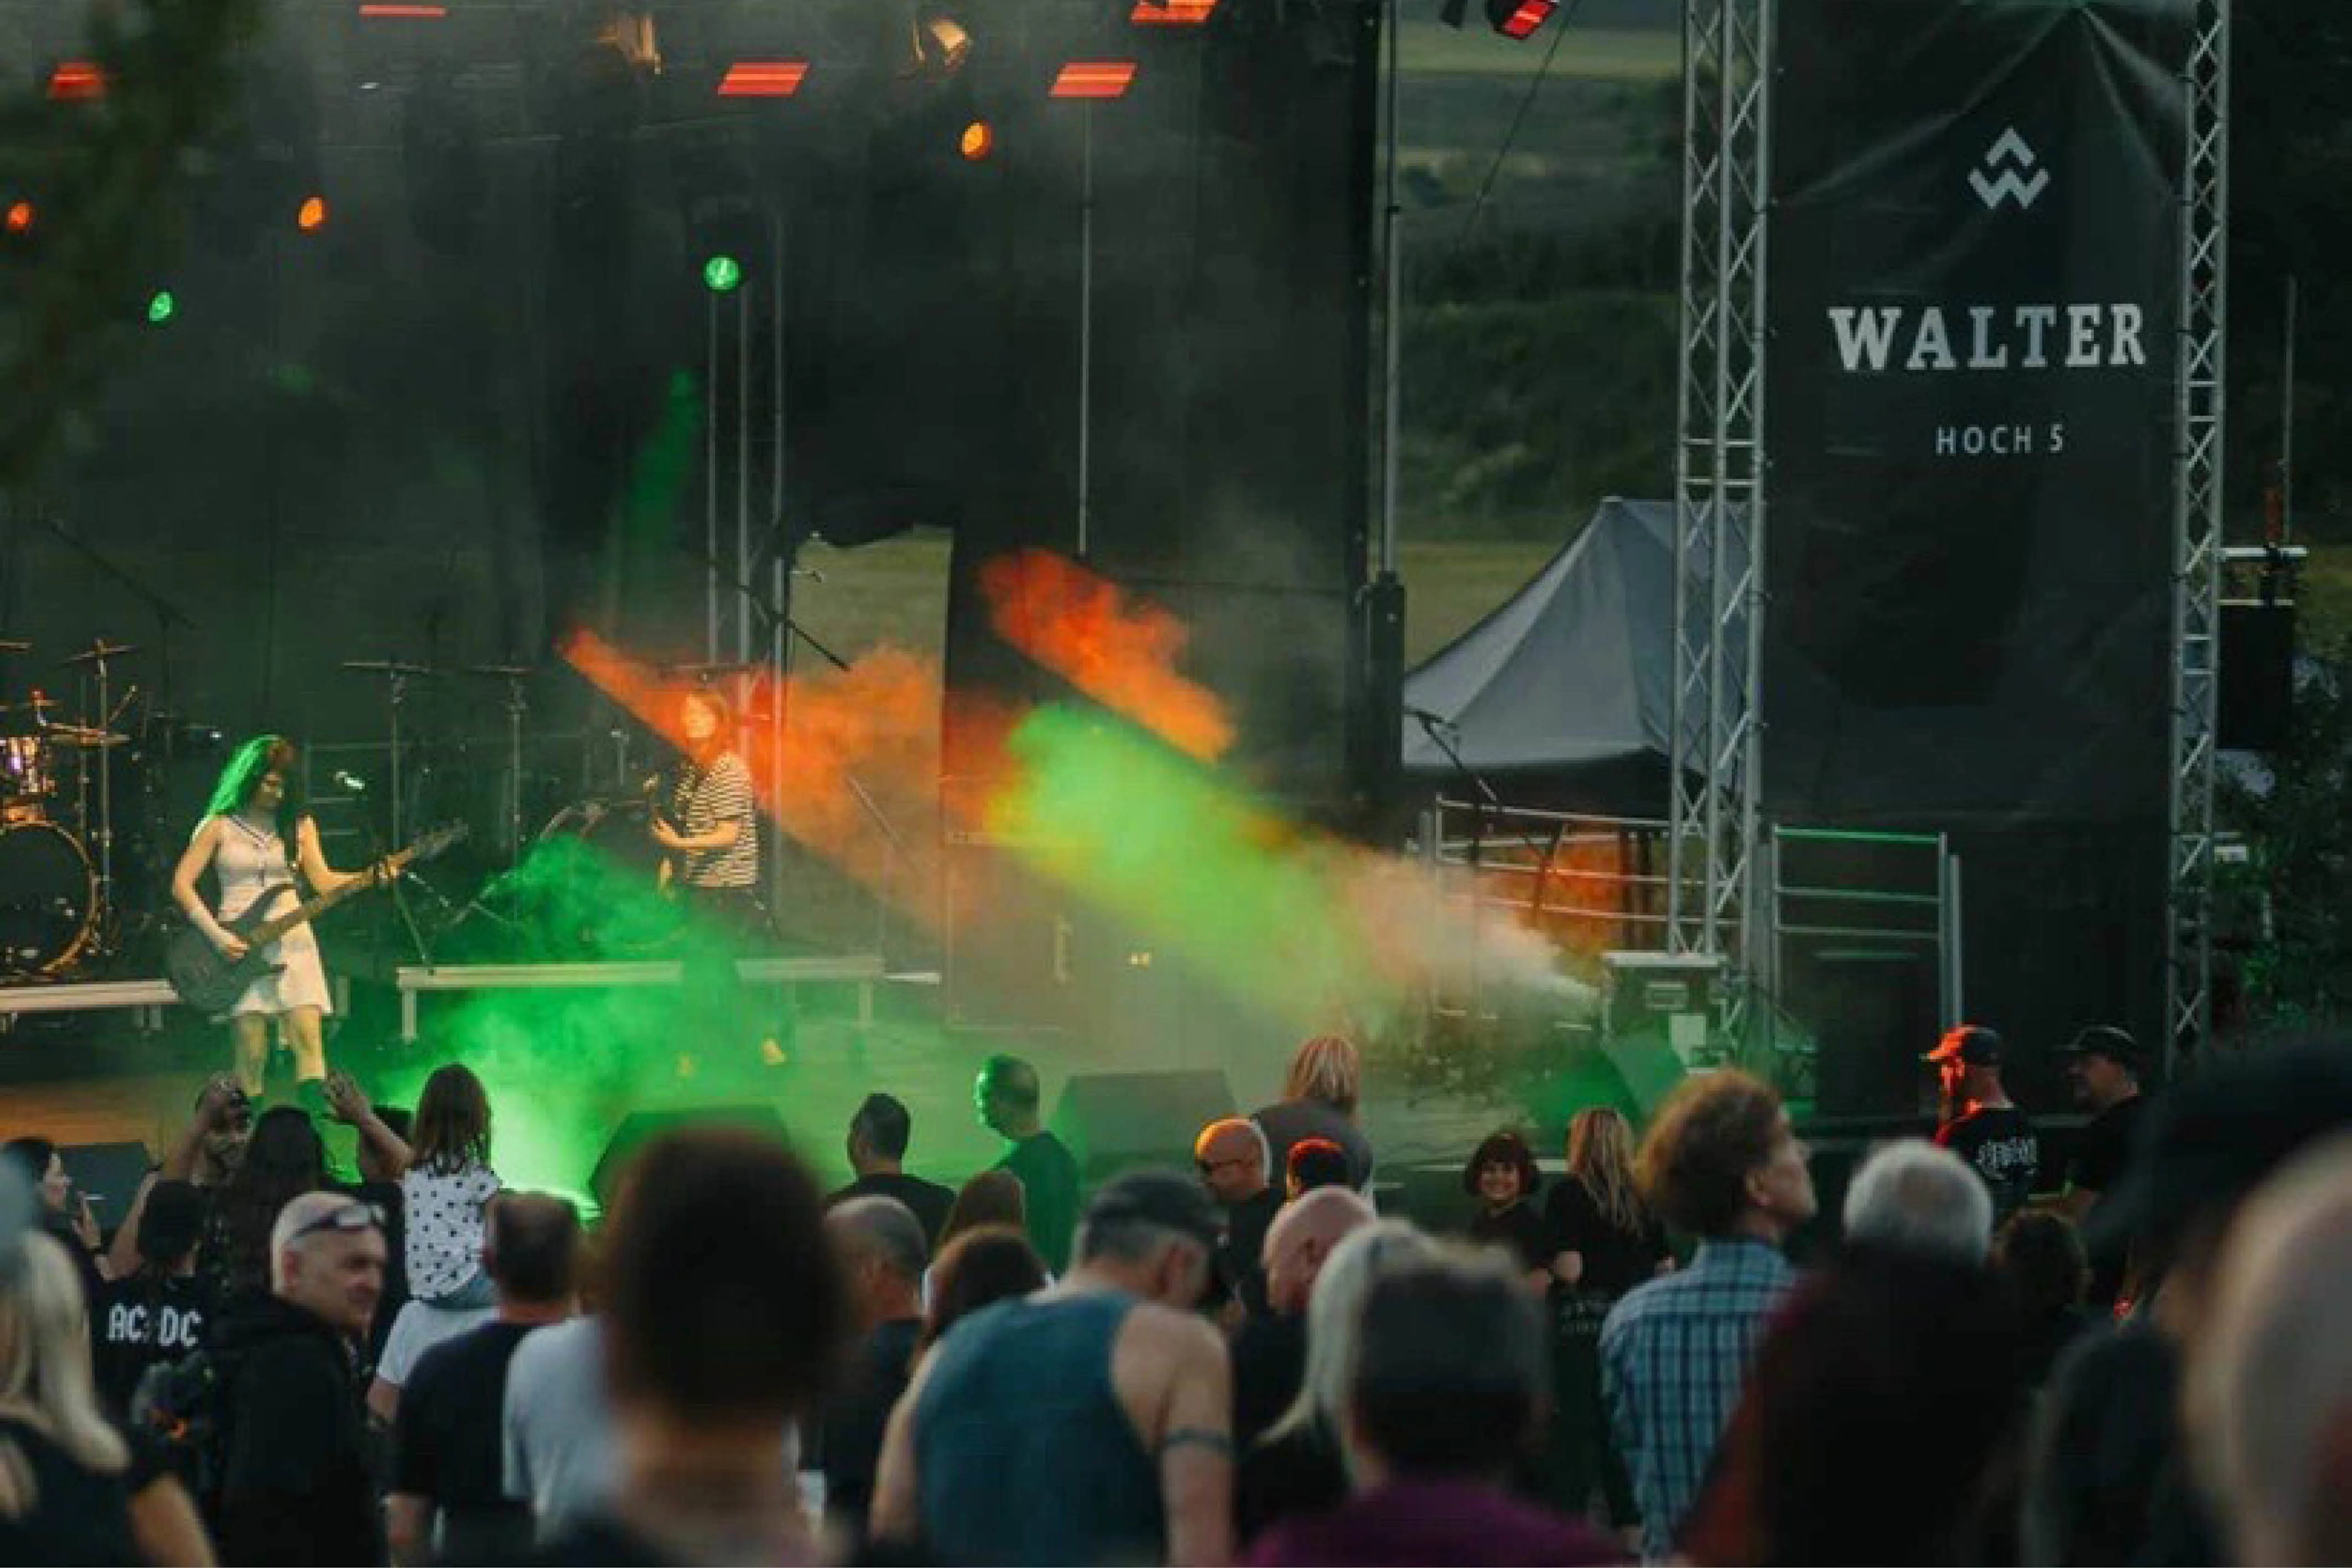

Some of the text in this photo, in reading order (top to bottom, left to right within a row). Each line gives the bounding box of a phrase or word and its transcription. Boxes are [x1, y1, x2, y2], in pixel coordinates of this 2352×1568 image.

[1828, 304, 2145, 371] WALTER
[1936, 423, 2064, 455] HOCH 5
